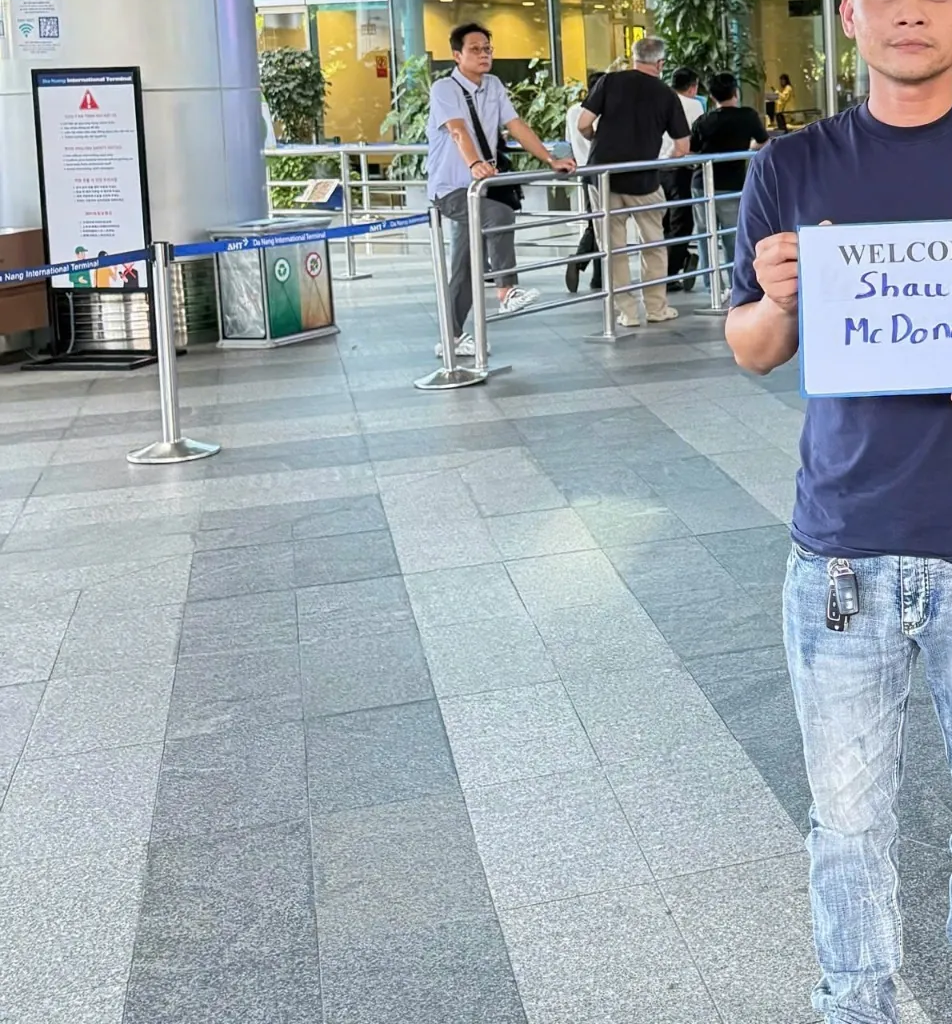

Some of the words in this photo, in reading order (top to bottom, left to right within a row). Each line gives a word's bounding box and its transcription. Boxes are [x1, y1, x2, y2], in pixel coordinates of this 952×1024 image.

[227, 242, 243, 250] AHT
[253, 239, 261, 247] Da
[275, 233, 306, 244] International
[306, 231, 326, 241] Terminal
[5, 272, 24, 282] Nang
[26, 264, 70, 278] International
[71, 259, 100, 271] Terminal
